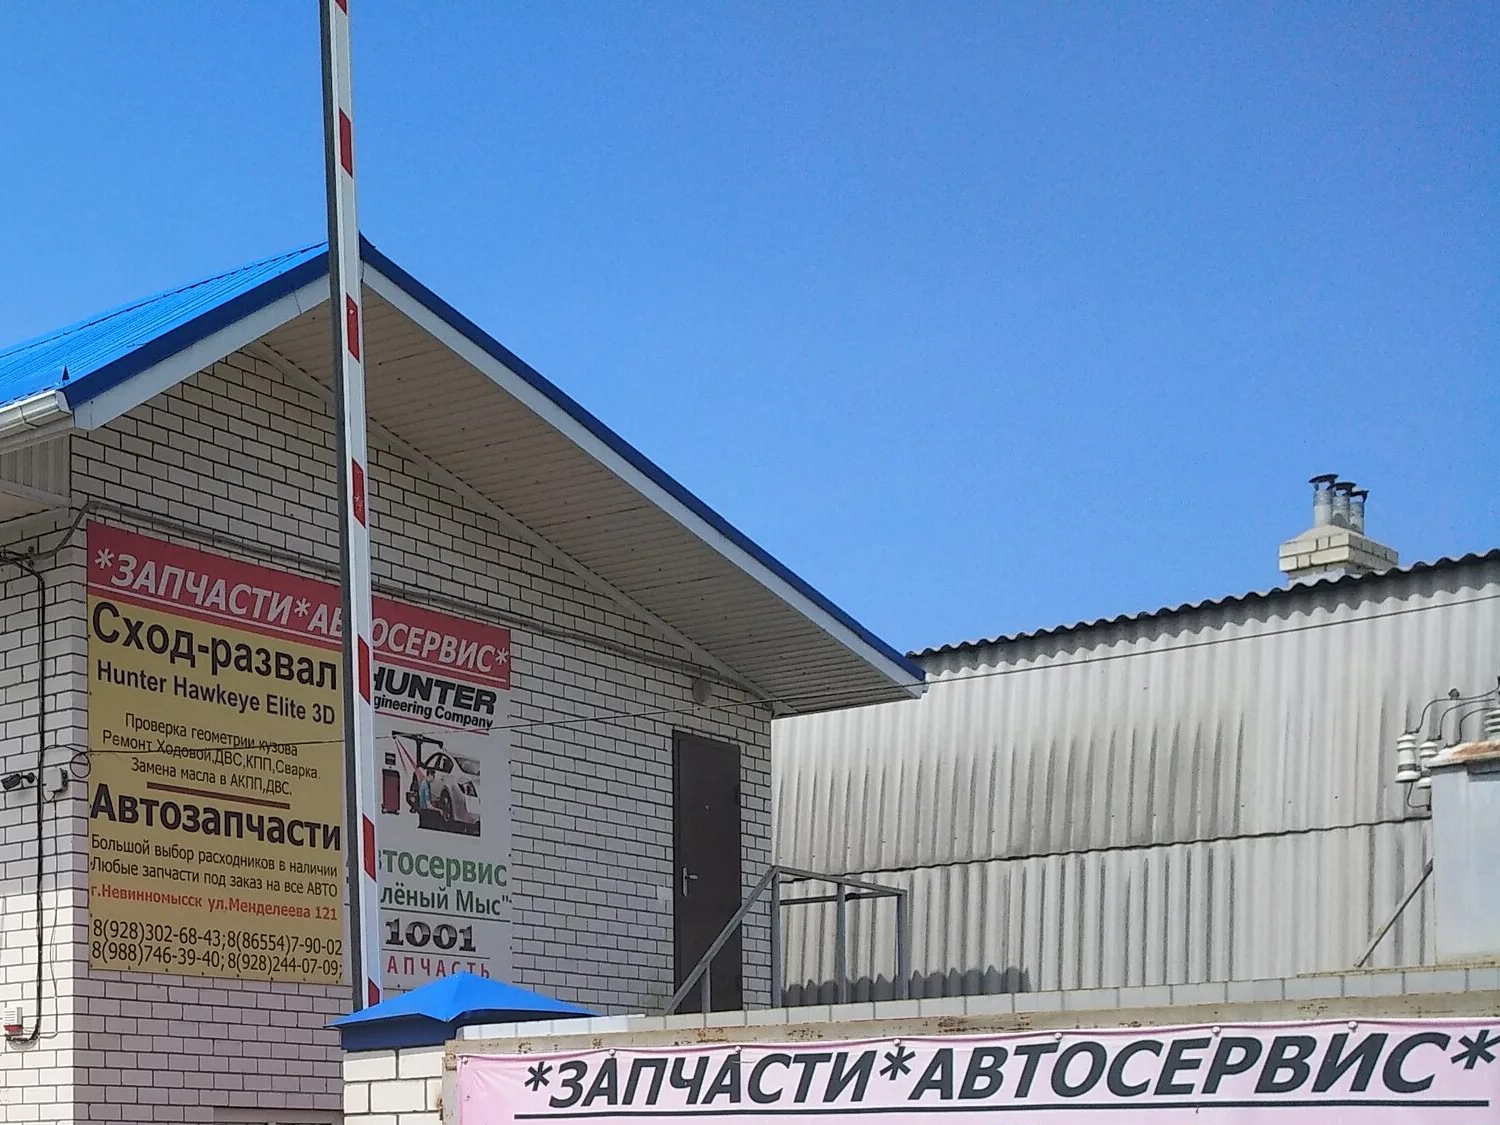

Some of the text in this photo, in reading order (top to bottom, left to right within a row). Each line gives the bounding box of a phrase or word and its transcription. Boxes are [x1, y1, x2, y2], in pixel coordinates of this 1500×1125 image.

[94, 548, 508, 672] ЗАПЧАСТИАВОСЕРВИС
[93, 601, 337, 690] Сход-развал
[97, 659, 335, 725] Hunter Hawkeye Elite 3D
[374, 694, 493, 731] gineering Company
[102, 730, 152, 752] Ремонт
[125, 713, 298, 757] Проверка геометрии кузова
[131, 757, 293, 796] Замена масла в АКПП,ДВС.
[90, 782, 341, 851] Автозапчасти
[91, 834, 338, 878] Большой выбор расходников в наличии
[379, 848, 507, 887] тосервис
[91, 856, 338, 898] Любые запчасти под заказ на все АВТО
[380, 881, 449, 910] лёный
[91, 884, 338, 921] г.Невинномысск ул.Менделеева 121
[385, 917, 476, 953] 1001
[387, 955, 490, 979] АПЧАСТЬ
